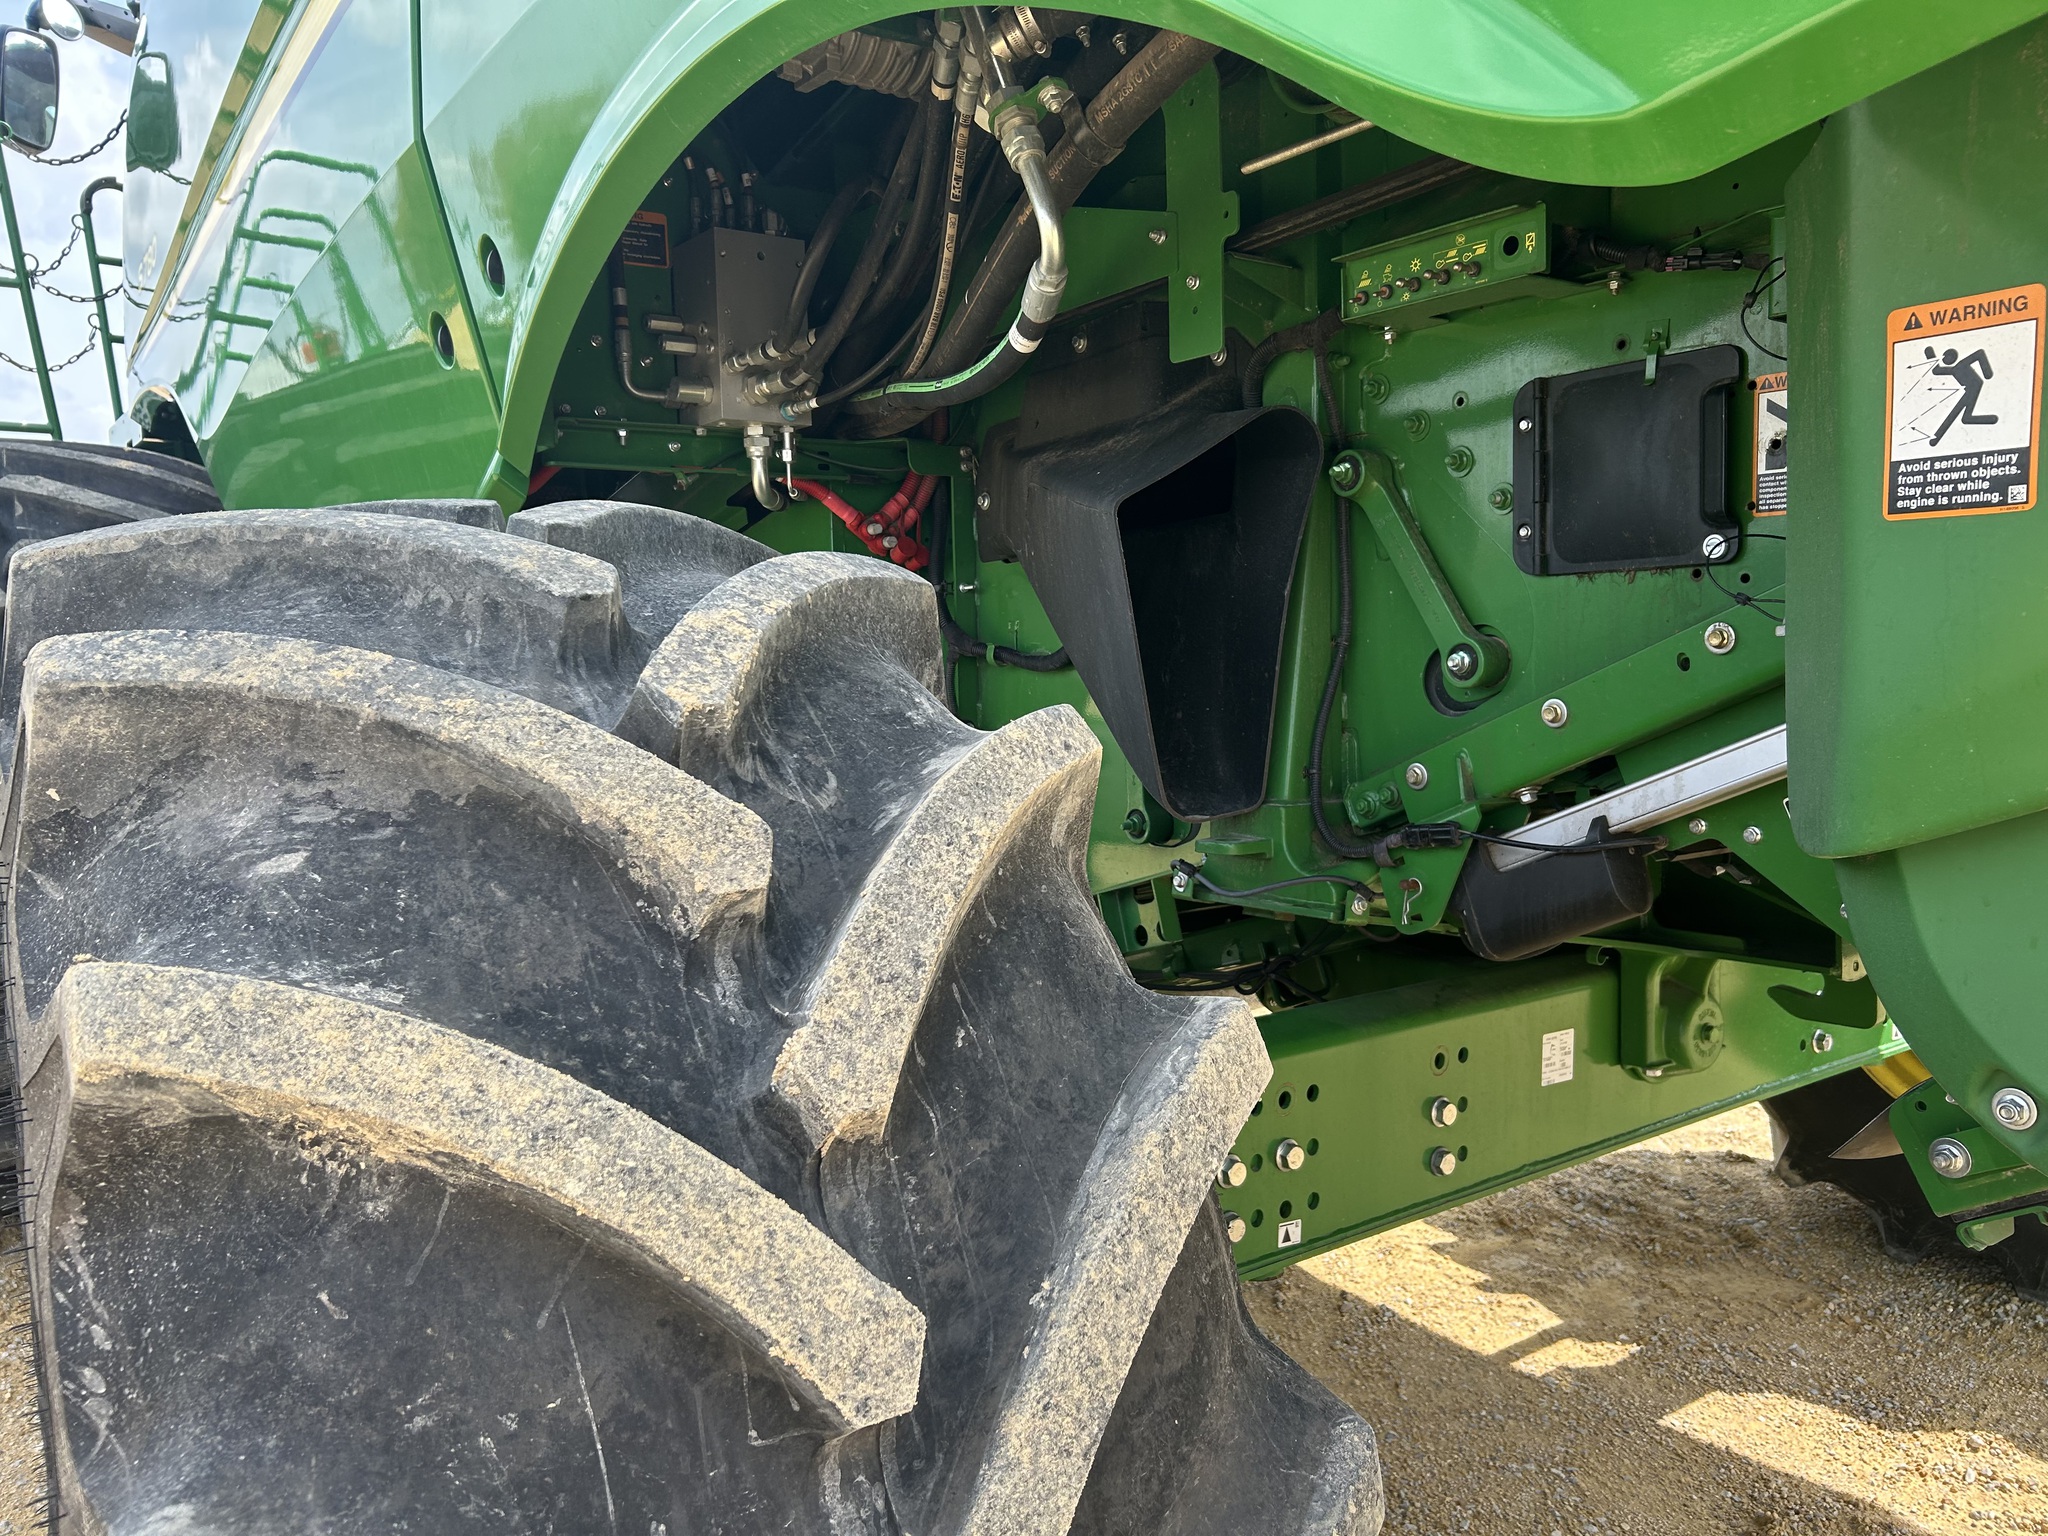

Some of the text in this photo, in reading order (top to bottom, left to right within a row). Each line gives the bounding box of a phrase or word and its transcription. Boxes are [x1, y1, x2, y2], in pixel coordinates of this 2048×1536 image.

[1093, 98, 1119, 125] MSHA
[1048, 144, 1077, 180] SUCTION
[1929, 294, 2029, 327] WARNING
[1897, 453, 2019, 474] Avoid serious injury
[1897, 465, 2021, 485] from thrown objects.
[1897, 479, 1990, 498] Stay clear while
[1896, 491, 2003, 510] engine is running.
